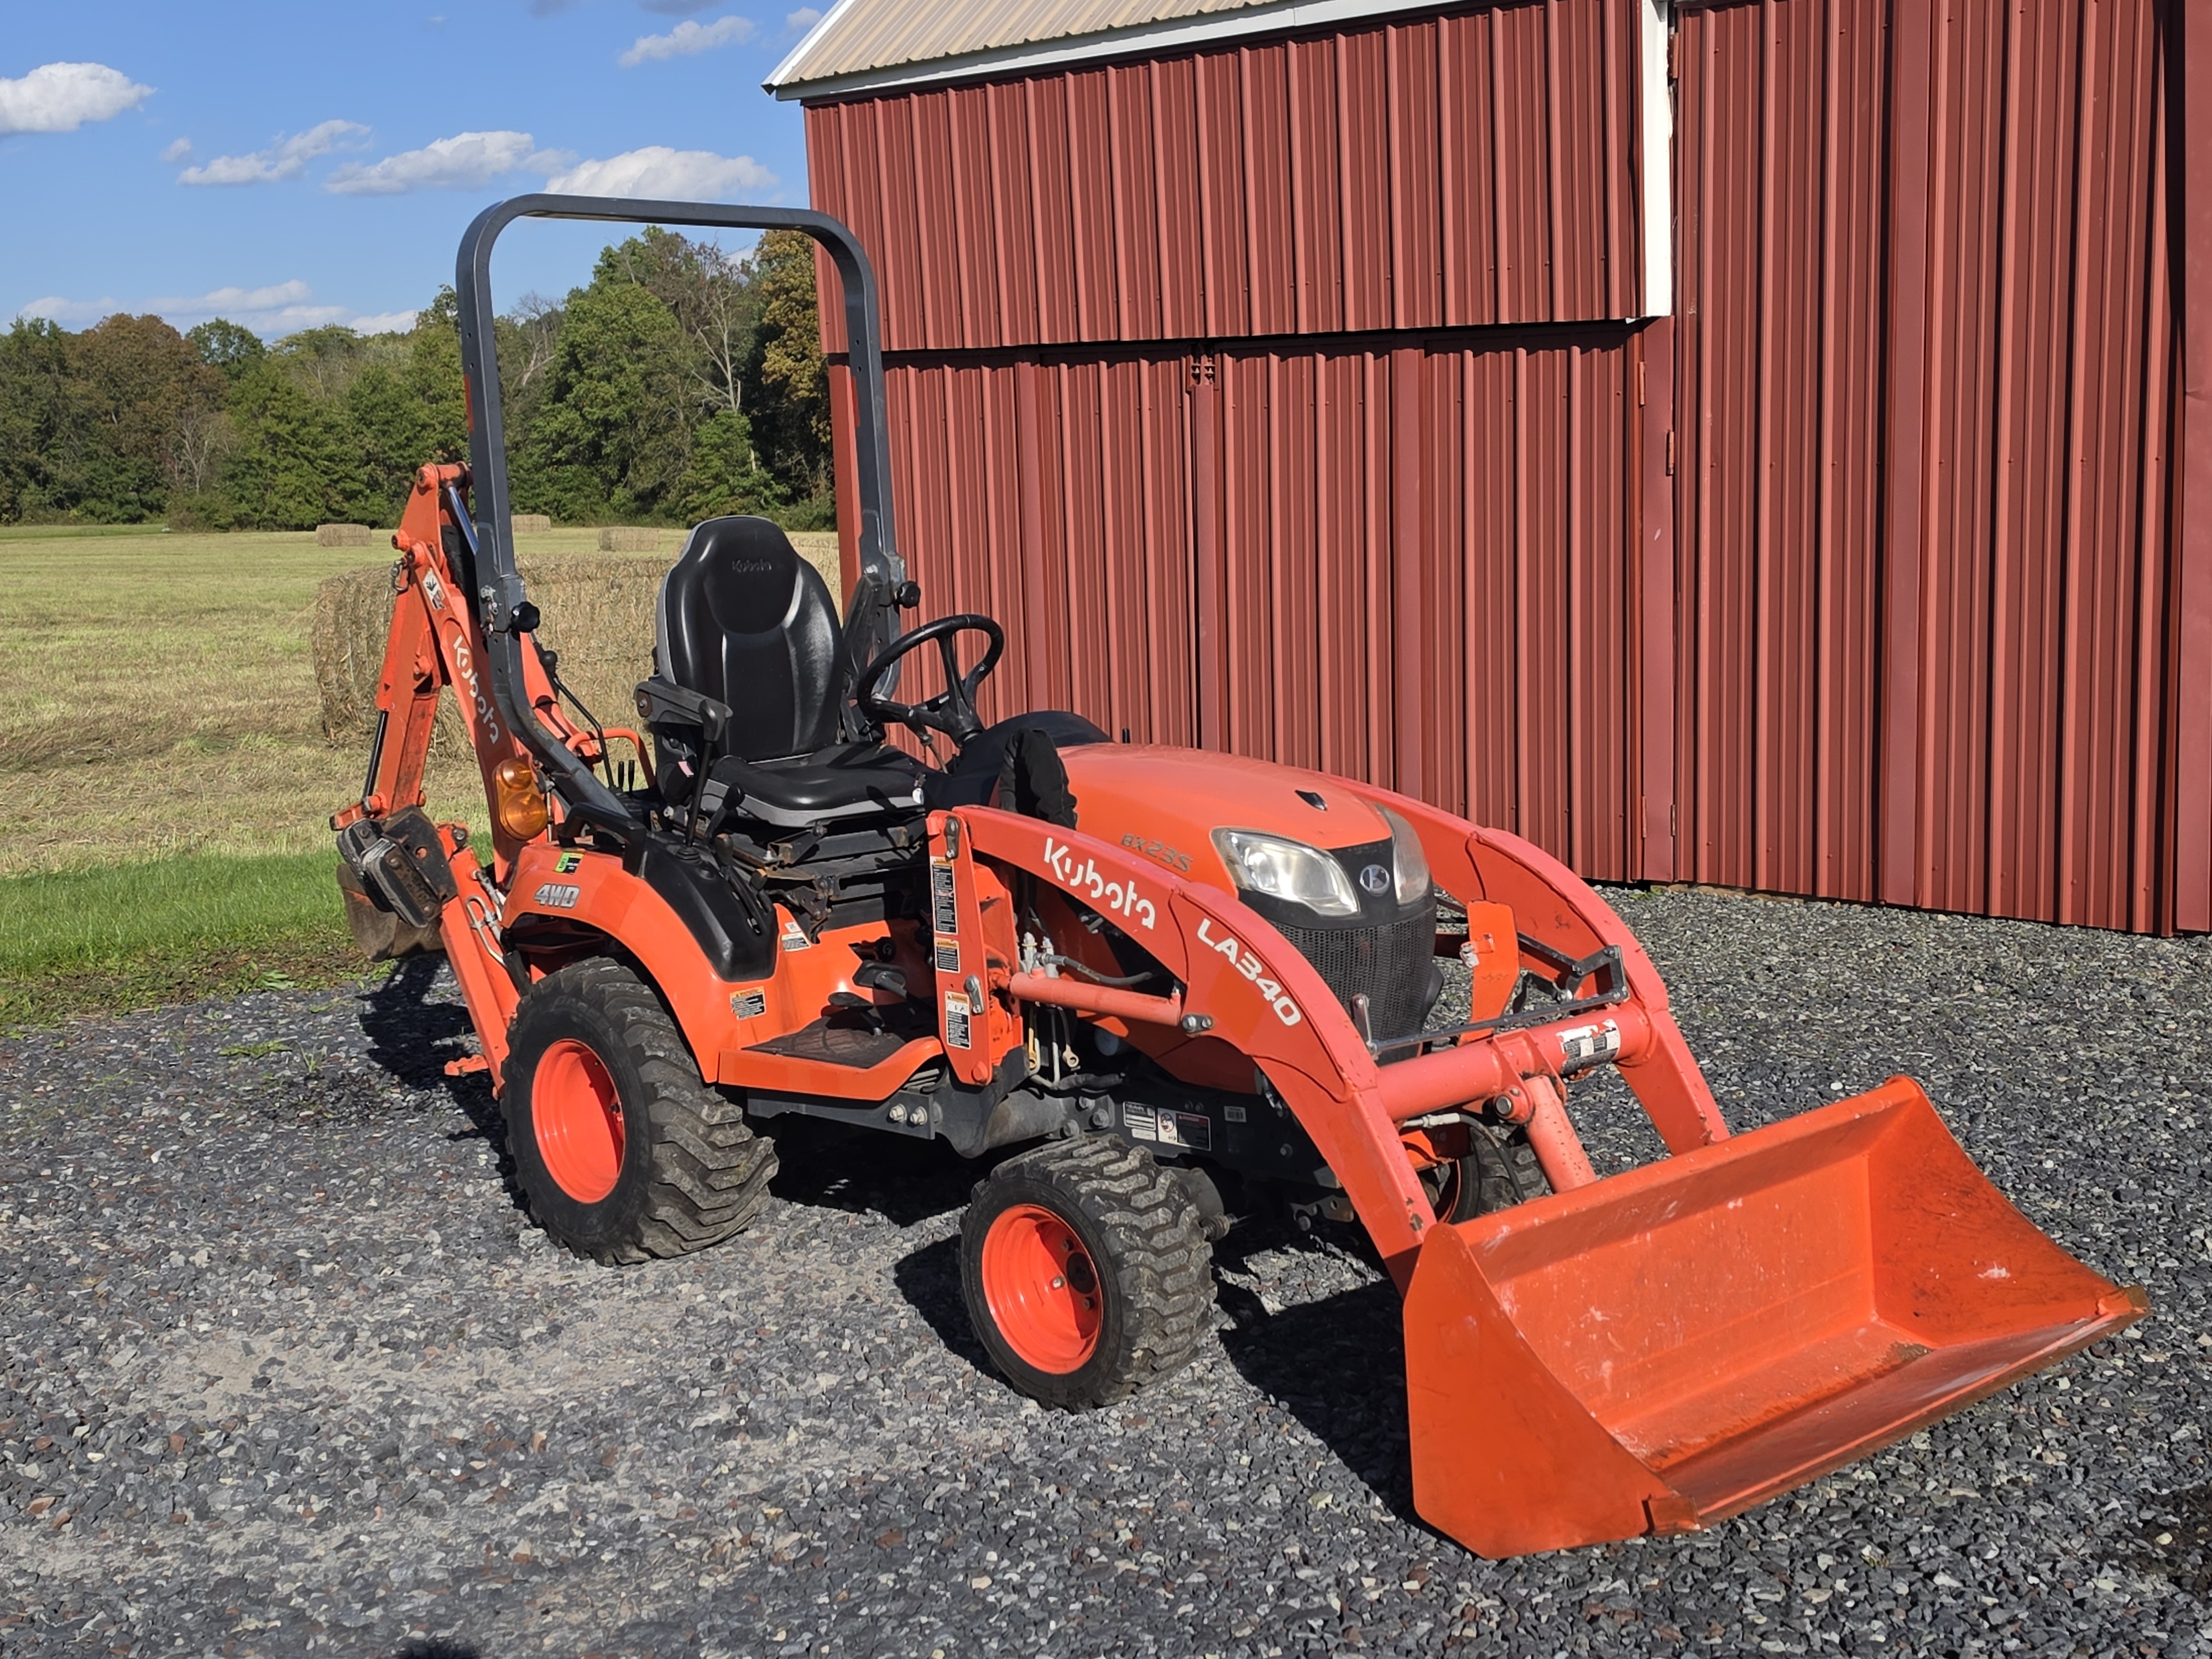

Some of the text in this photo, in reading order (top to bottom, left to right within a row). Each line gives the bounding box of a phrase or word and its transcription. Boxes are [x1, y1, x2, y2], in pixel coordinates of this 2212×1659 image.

[453, 635, 499, 744] Kubota
[534, 883, 581, 909] 4WD
[1044, 837, 1156, 930] Kubota
[1120, 833, 1194, 872] BX23S
[1197, 918, 1302, 1026] LA340
